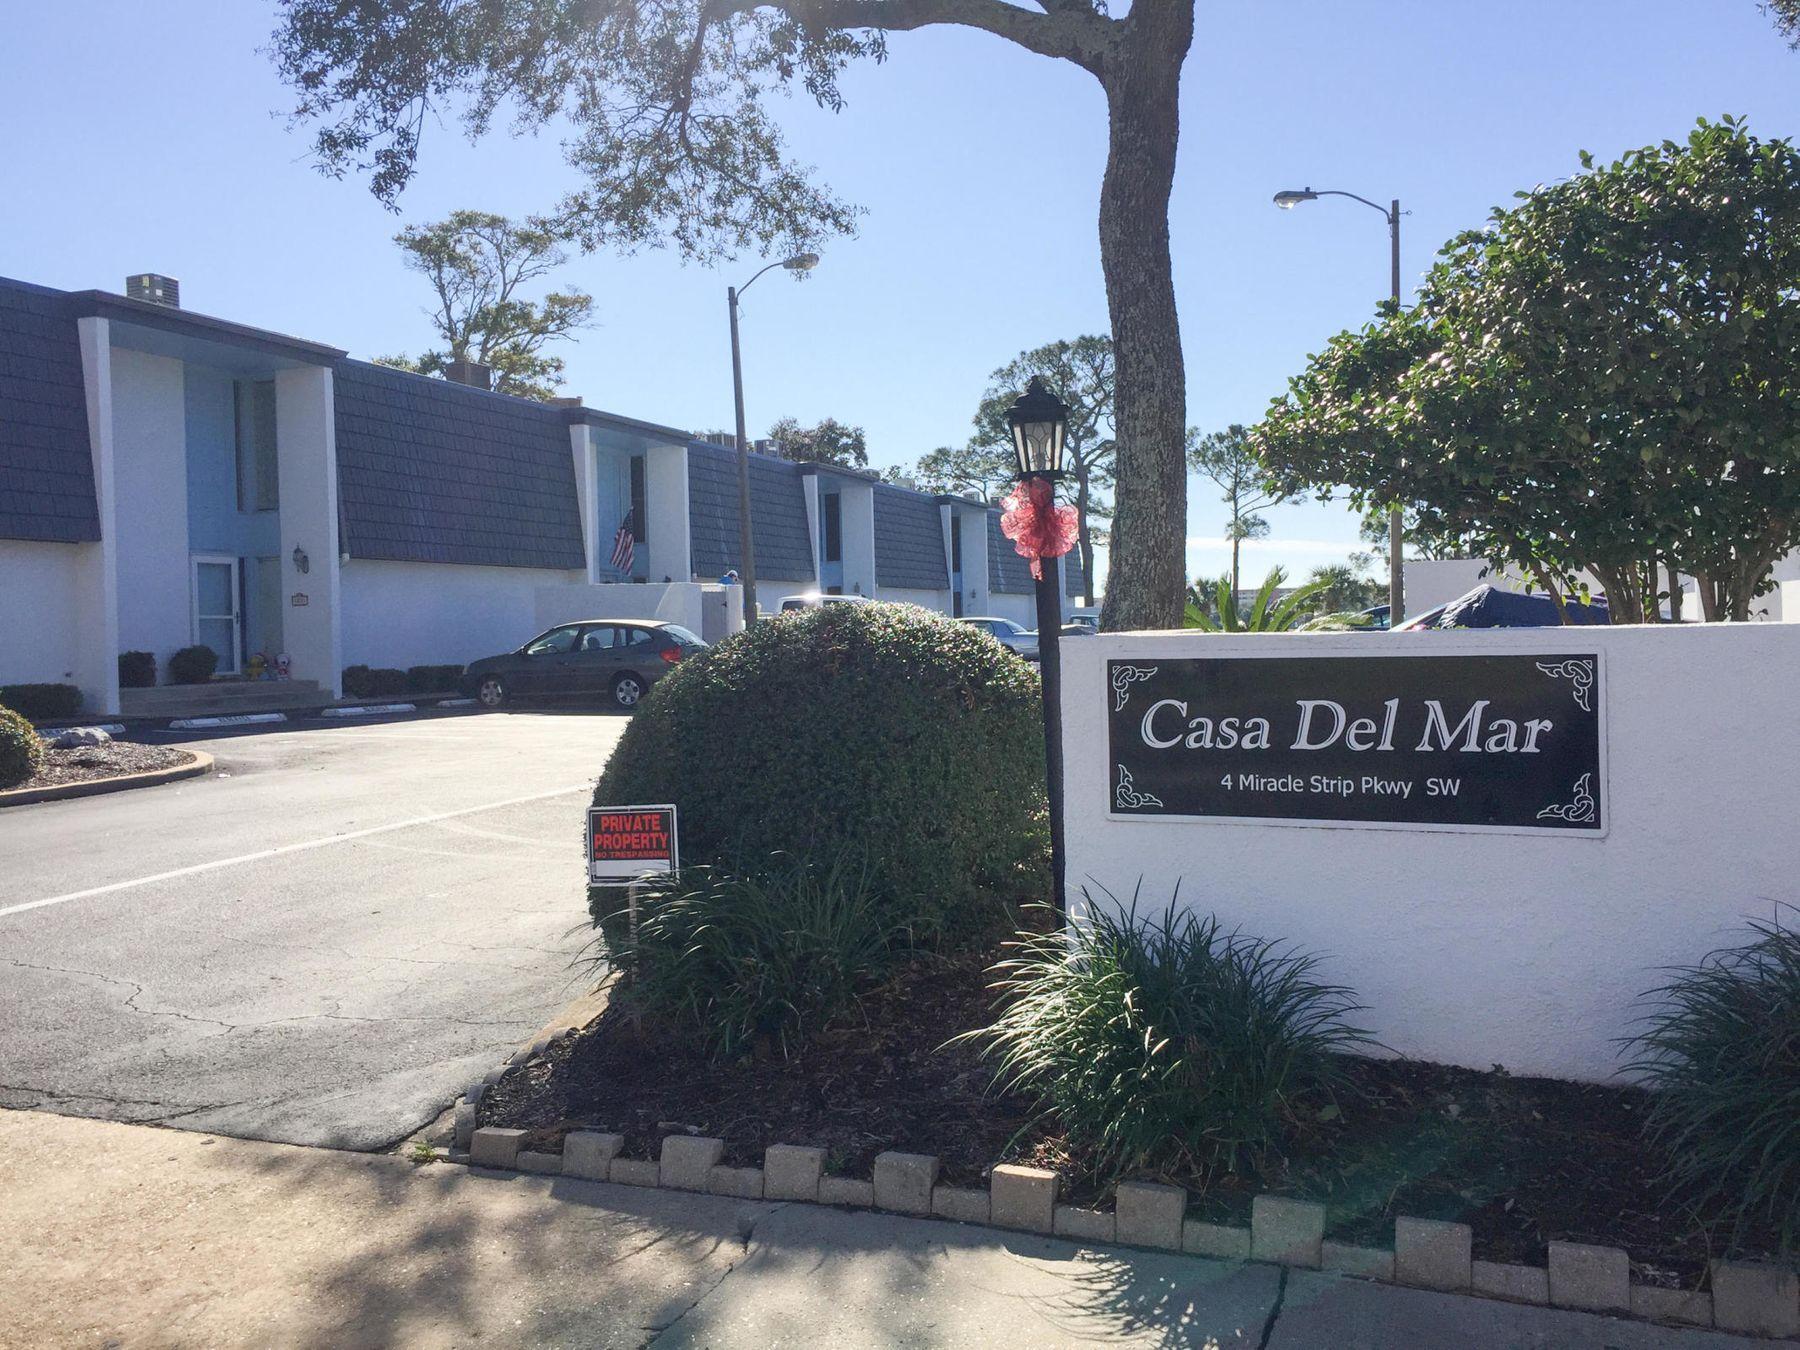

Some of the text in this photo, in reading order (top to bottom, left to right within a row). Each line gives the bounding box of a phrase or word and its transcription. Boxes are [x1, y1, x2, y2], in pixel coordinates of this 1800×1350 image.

[1141, 698, 1553, 752] Casa Del Mar
[1221, 774, 1460, 798] 4 Miracle Strip Pkwy SW
[601, 814, 661, 831] PRIVATE
[594, 832, 668, 849] PROPERTY
